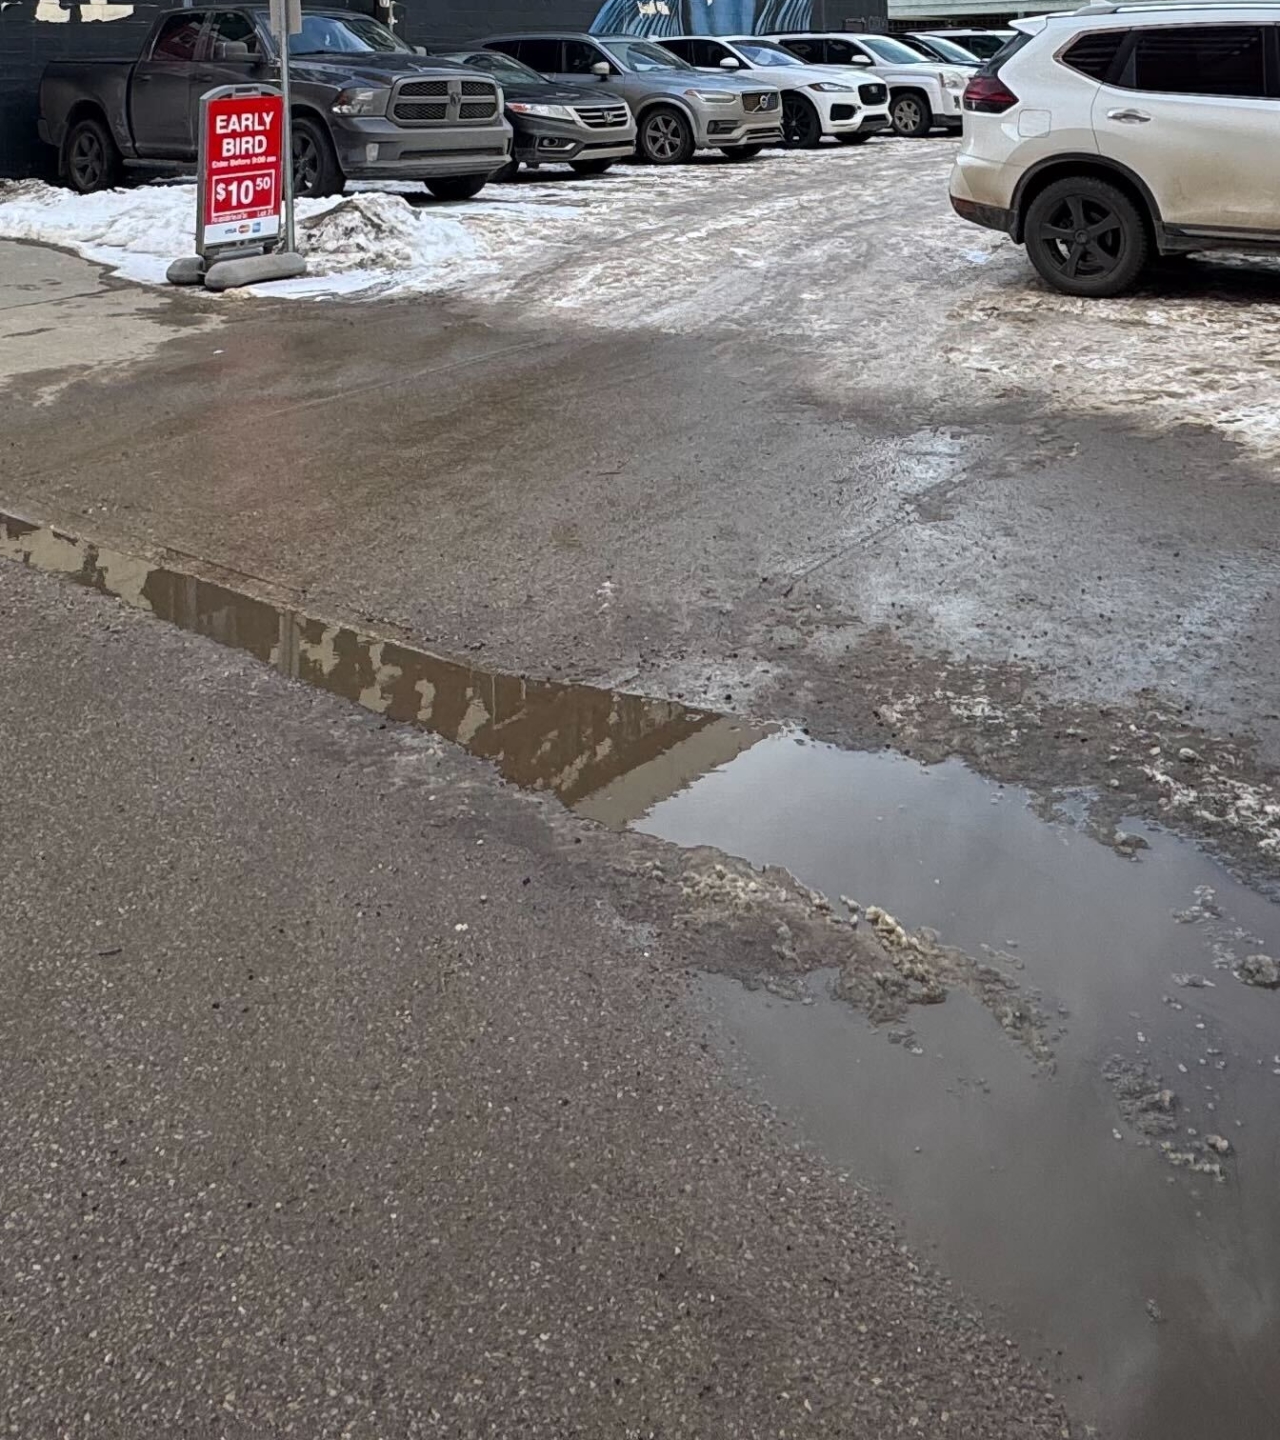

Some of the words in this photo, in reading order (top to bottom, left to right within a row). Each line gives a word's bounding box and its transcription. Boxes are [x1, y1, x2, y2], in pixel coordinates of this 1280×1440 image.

[215, 111, 274, 134] EARLY
[222, 135, 268, 157] BIRD
[229, 158, 251, 167] Before
